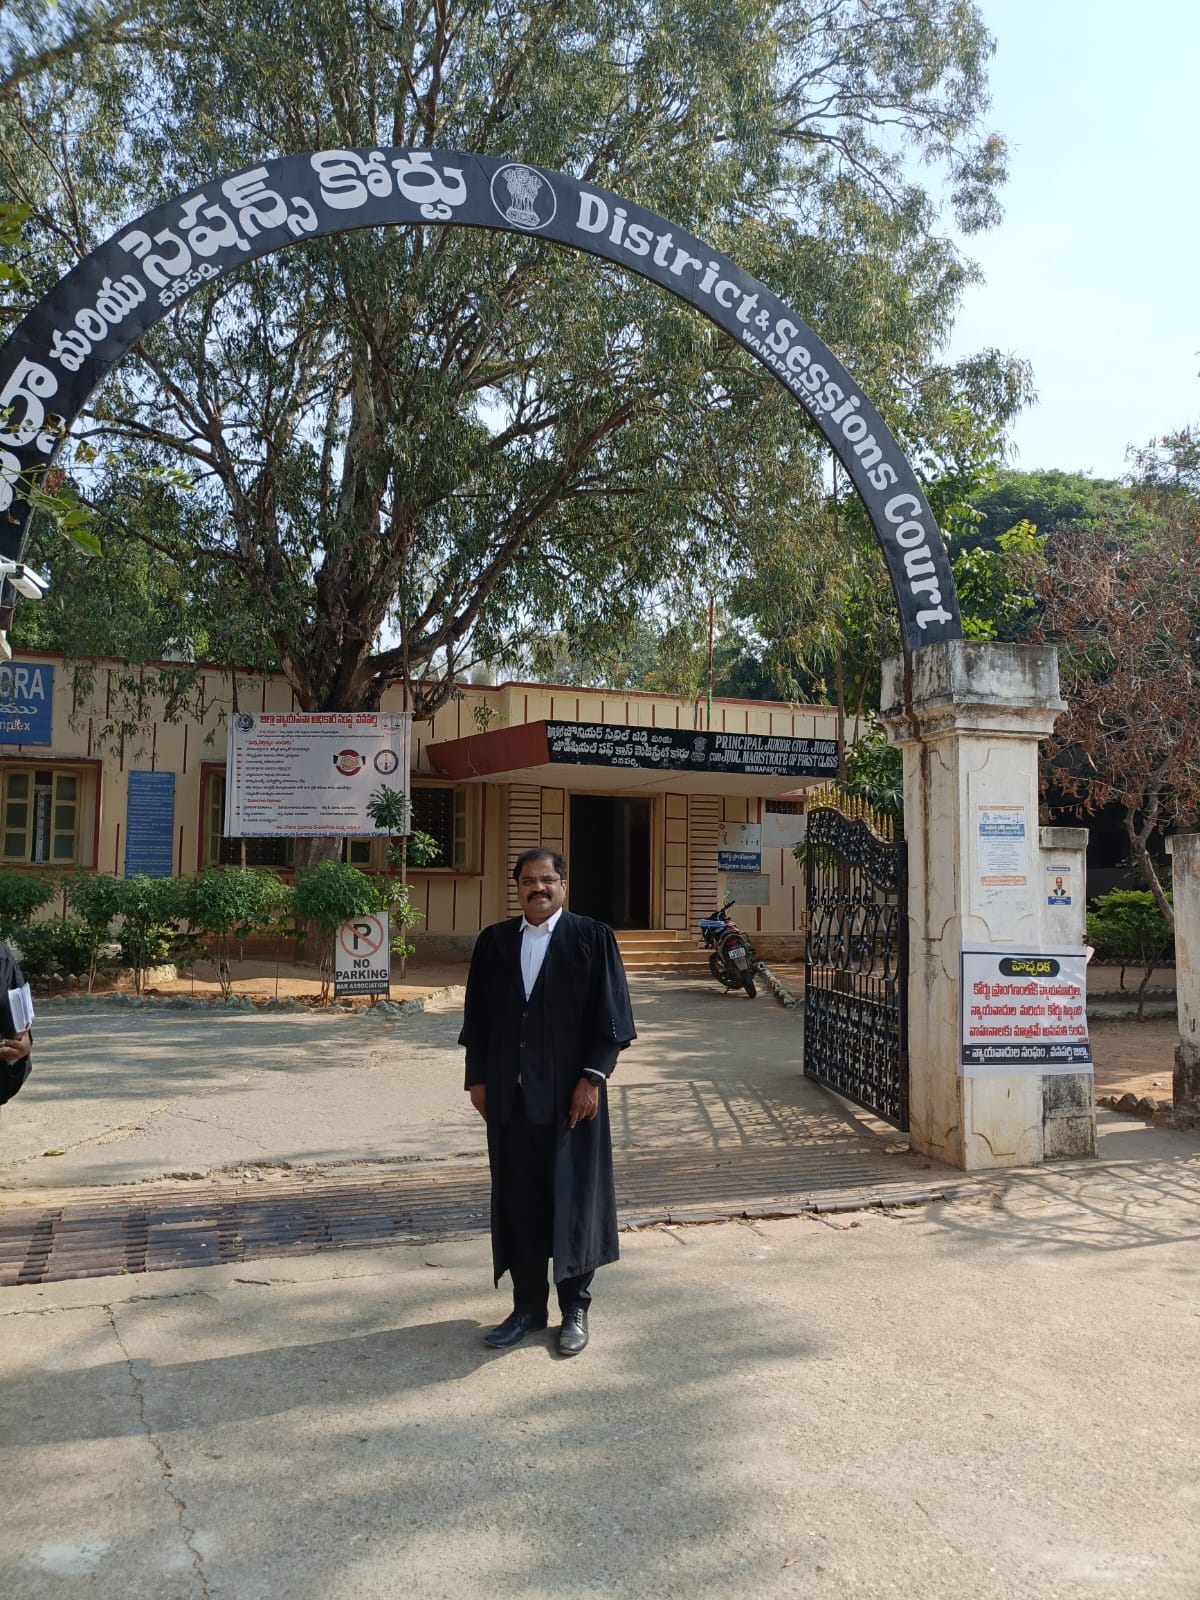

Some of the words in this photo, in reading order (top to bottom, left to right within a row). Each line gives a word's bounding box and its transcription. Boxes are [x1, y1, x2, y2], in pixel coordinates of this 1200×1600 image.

[49, 273, 147, 371] మరియు
[311, 150, 467, 220] కోర్టు
[576, 191, 760, 324] District
[753, 309, 770, 331] &
[765, 318, 898, 491] Sessions
[884, 493, 952, 629] Court
[604, 727, 631, 740] సివిల్
[651, 735, 673, 744] మరియు
[715, 735, 764, 750] PRINCIPAL
[765, 738, 791, 751] JUNIOR
[791, 740, 809, 753] CIVIL
[810, 741, 837, 754] JUDGE
[742, 751, 788, 765] MAGISTRATE
[788, 754, 798, 766] OF
[797, 754, 819, 767] FIRST
[818, 756, 838, 768] CLASS
[353, 959, 369, 968] NO
[1011, 960, 1051, 976] హెచ్చరిక
[336, 969, 387, 980] PARKING
[973, 981, 990, 1000] కోర్టు
[970, 1004, 1017, 1020] న్యాయవాదుల
[1019, 1004, 1046, 1015] మరియు
[1047, 1003, 1062, 1021] కోర్టు
[969, 1024, 1012, 1037] వాహనాలకు
[1013, 1023, 1042, 1038] మాత్రమే
[972, 1046, 1020, 1062] న్యాయవాదుల
[1050, 1045, 1073, 1063] వనపర్తి
